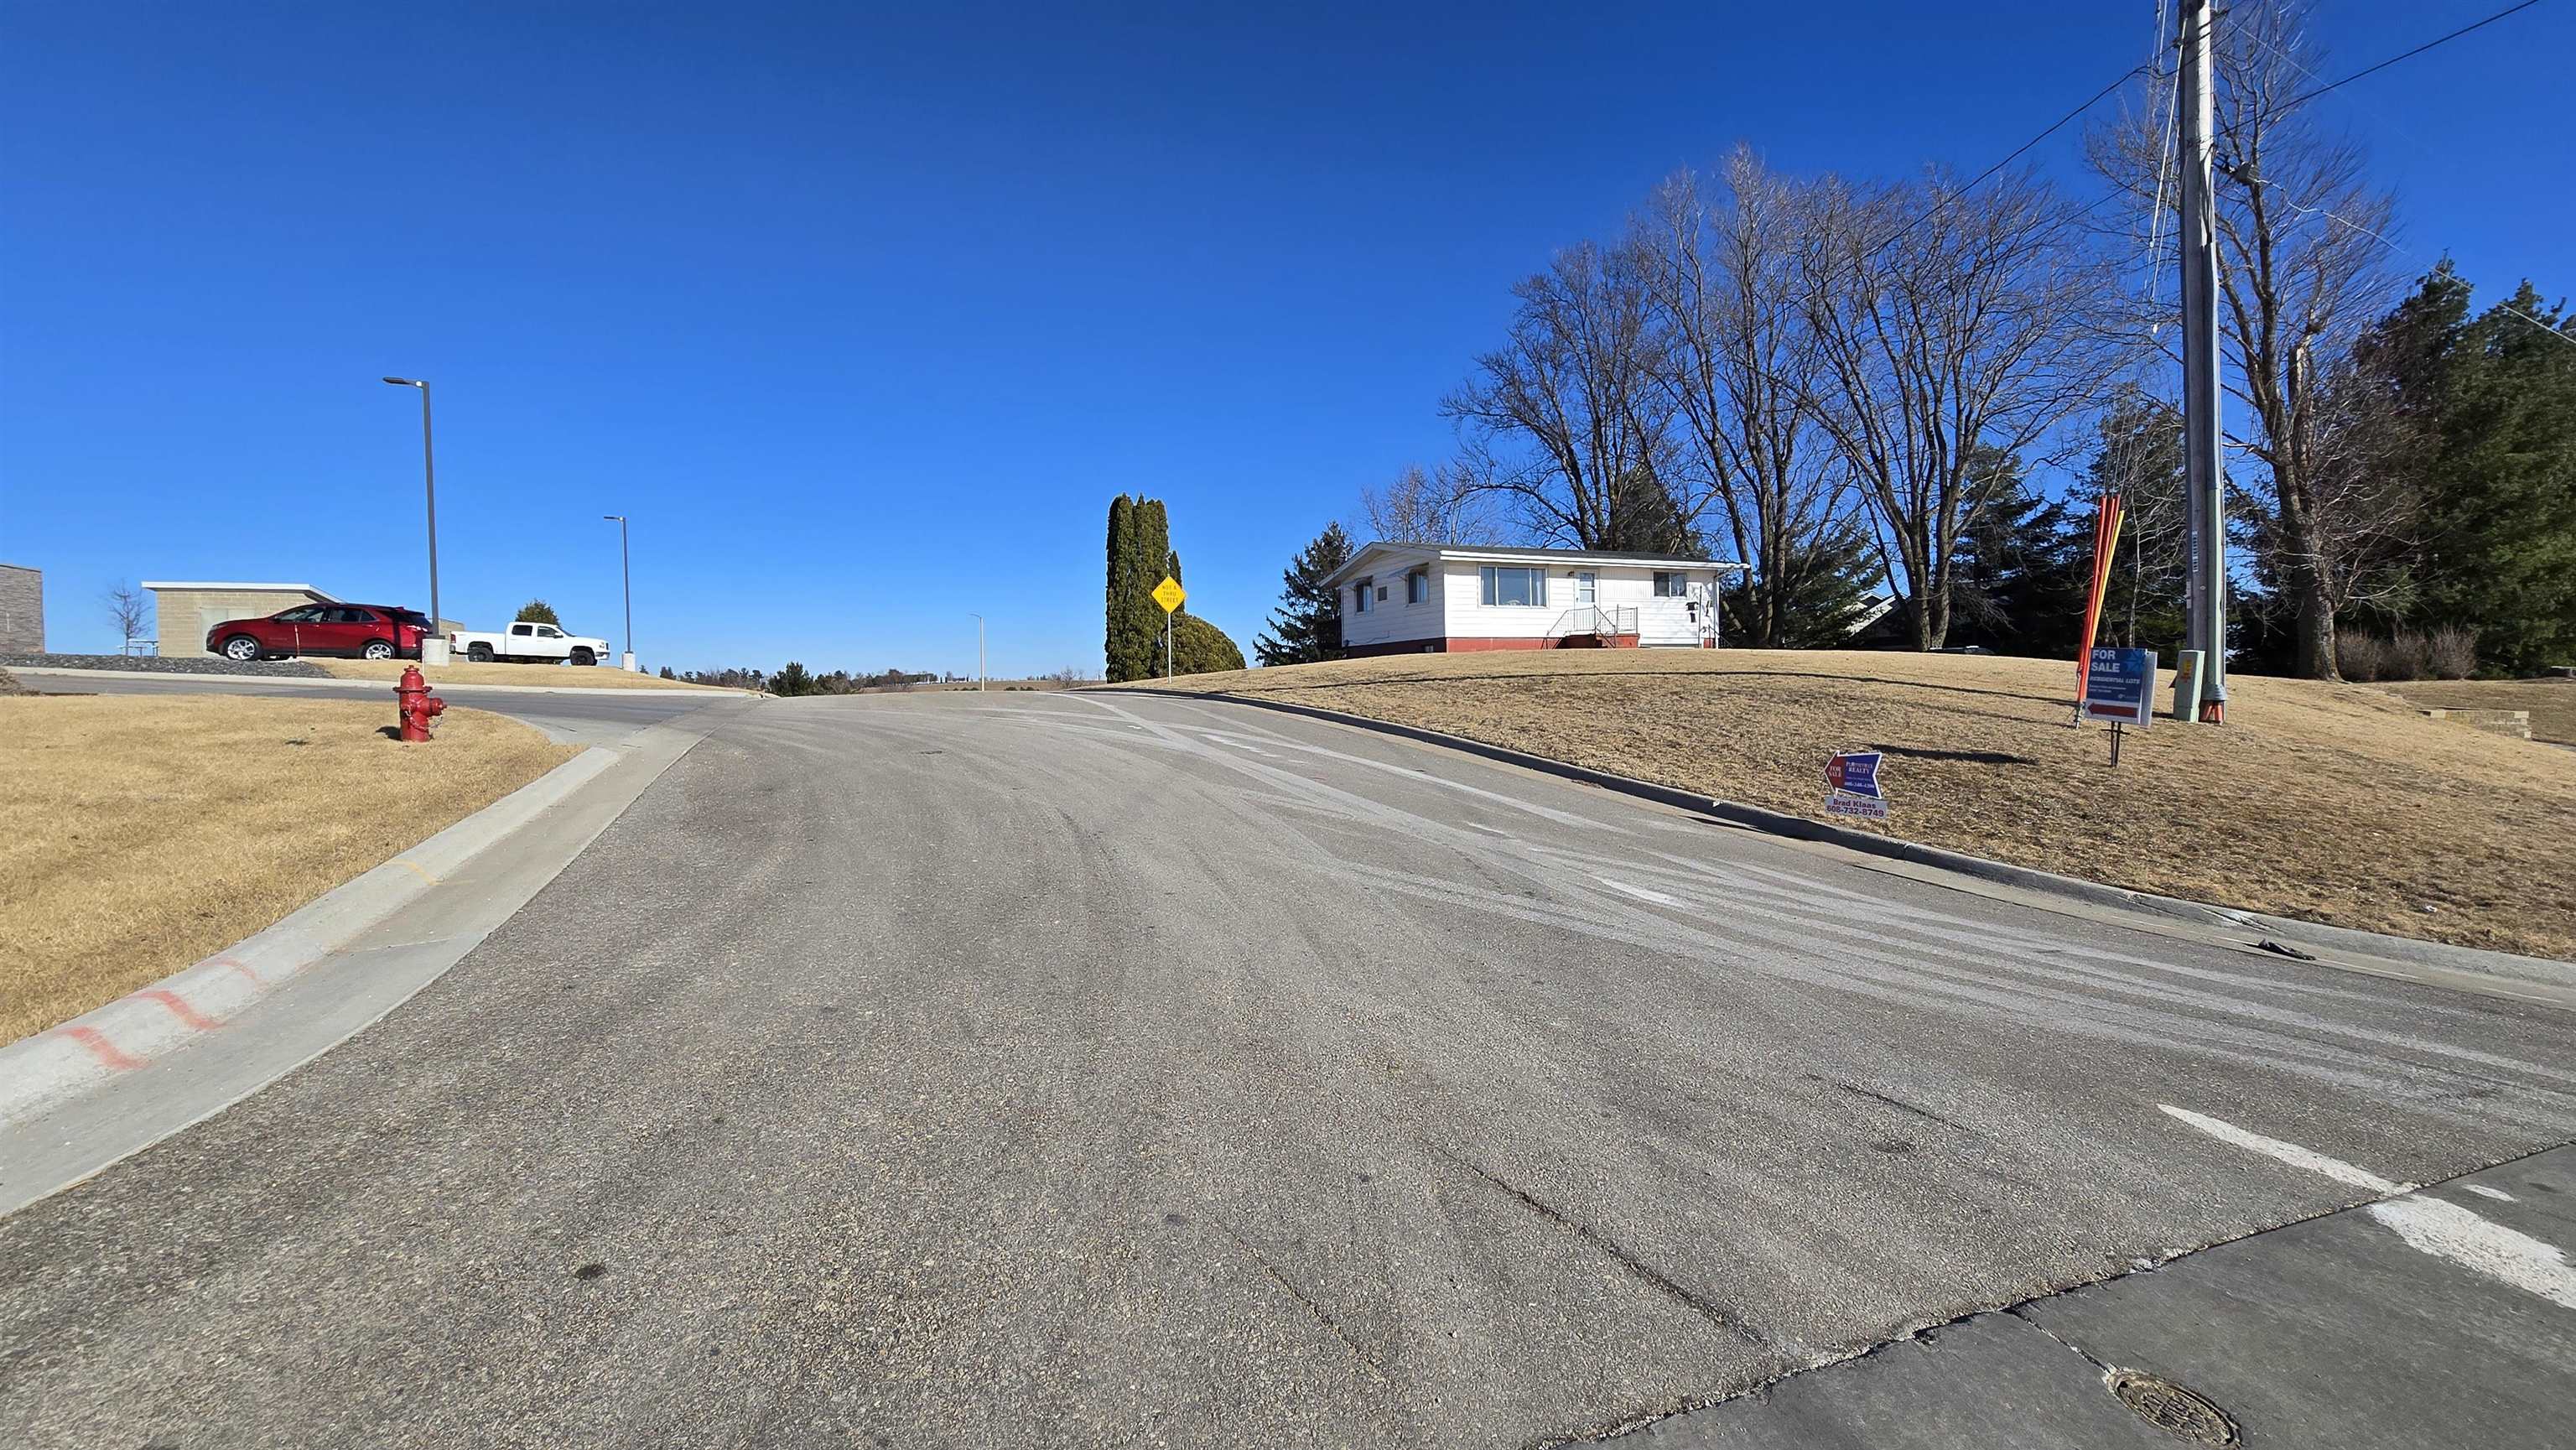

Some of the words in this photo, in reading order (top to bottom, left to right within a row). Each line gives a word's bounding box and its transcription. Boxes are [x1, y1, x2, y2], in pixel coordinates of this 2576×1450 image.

[2092, 649, 2116, 660] FOR
[2091, 662, 2121, 673] SALE
[1833, 798, 1851, 807] Brad
[1853, 800, 1877, 808] Klaas
[1826, 805, 1884, 817] 608-732-8749
